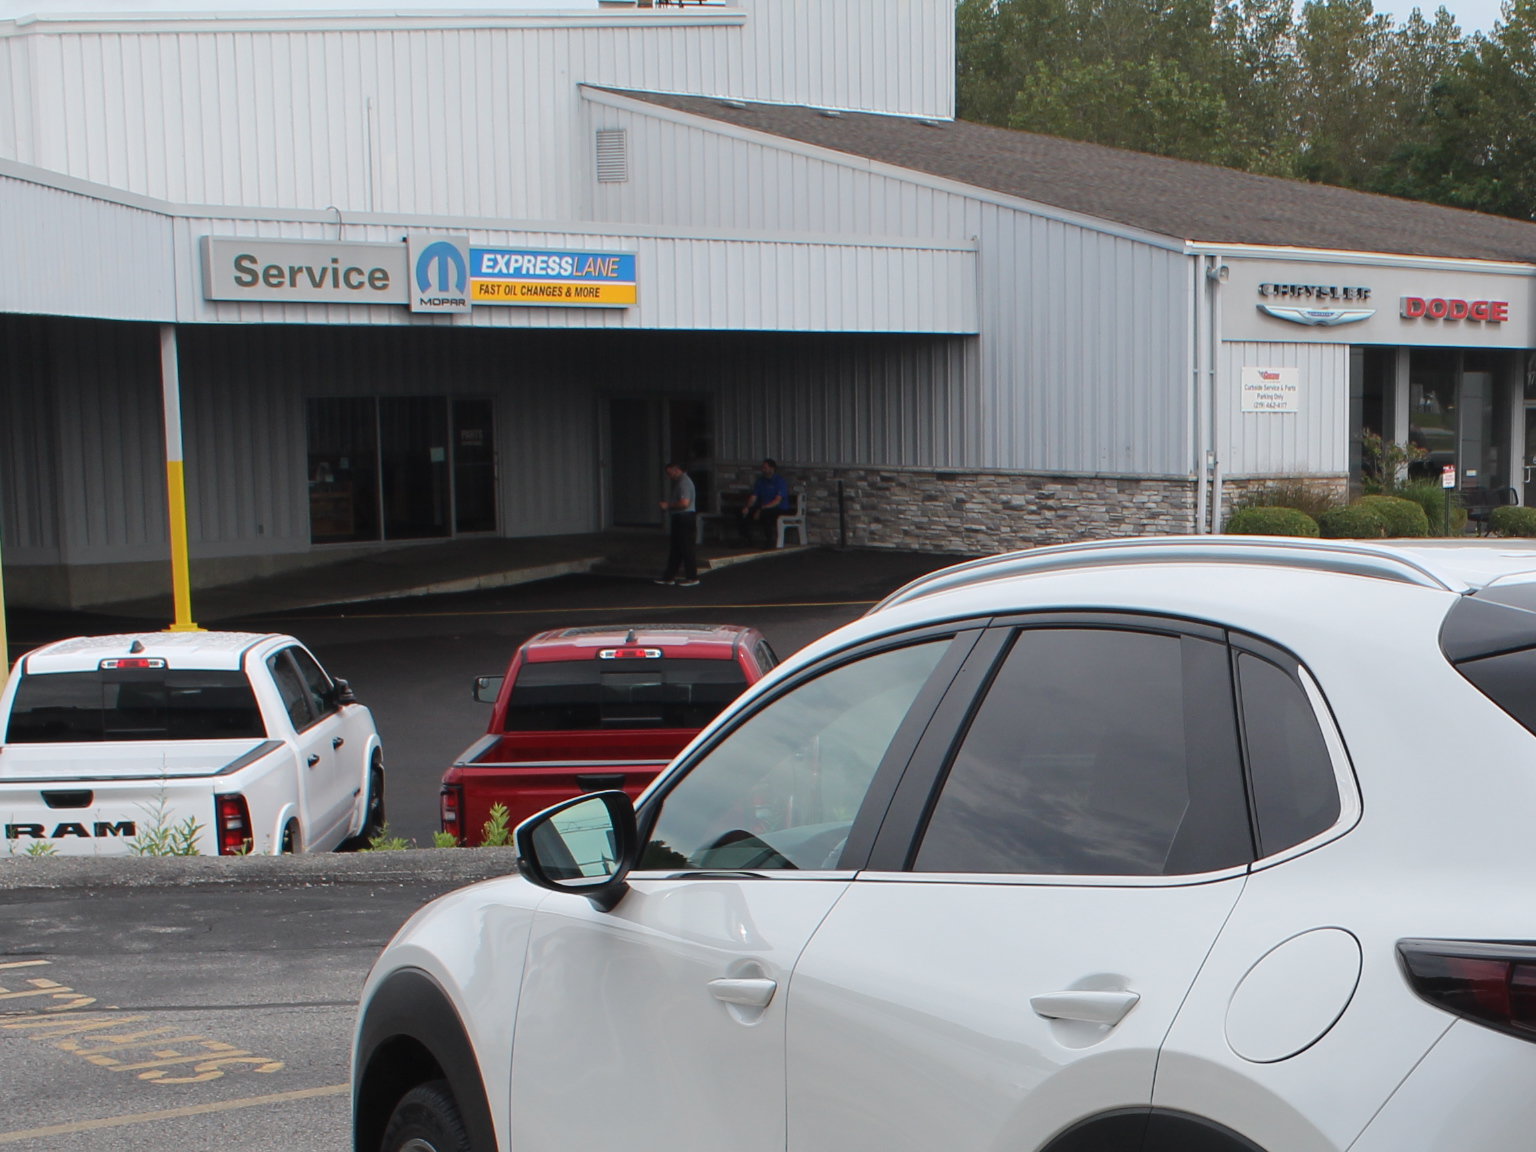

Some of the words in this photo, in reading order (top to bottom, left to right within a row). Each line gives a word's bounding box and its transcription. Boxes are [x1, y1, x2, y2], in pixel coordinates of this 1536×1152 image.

[233, 253, 390, 291] Service
[480, 253, 621, 278] EXPRESSLANE
[479, 283, 502, 295] FAST
[504, 285, 518, 296] OIL
[520, 286, 564, 297] CHANGES
[565, 287, 572, 298] &
[574, 287, 601, 298] MORE
[1258, 282, 1372, 301] CHRYSLER
[419, 297, 466, 307] MOPAR
[1402, 296, 1509, 322] DODGE
[1256, 392, 1274, 401] Parking
[1273, 393, 1284, 401] Only
[4, 821, 137, 839] RAM
